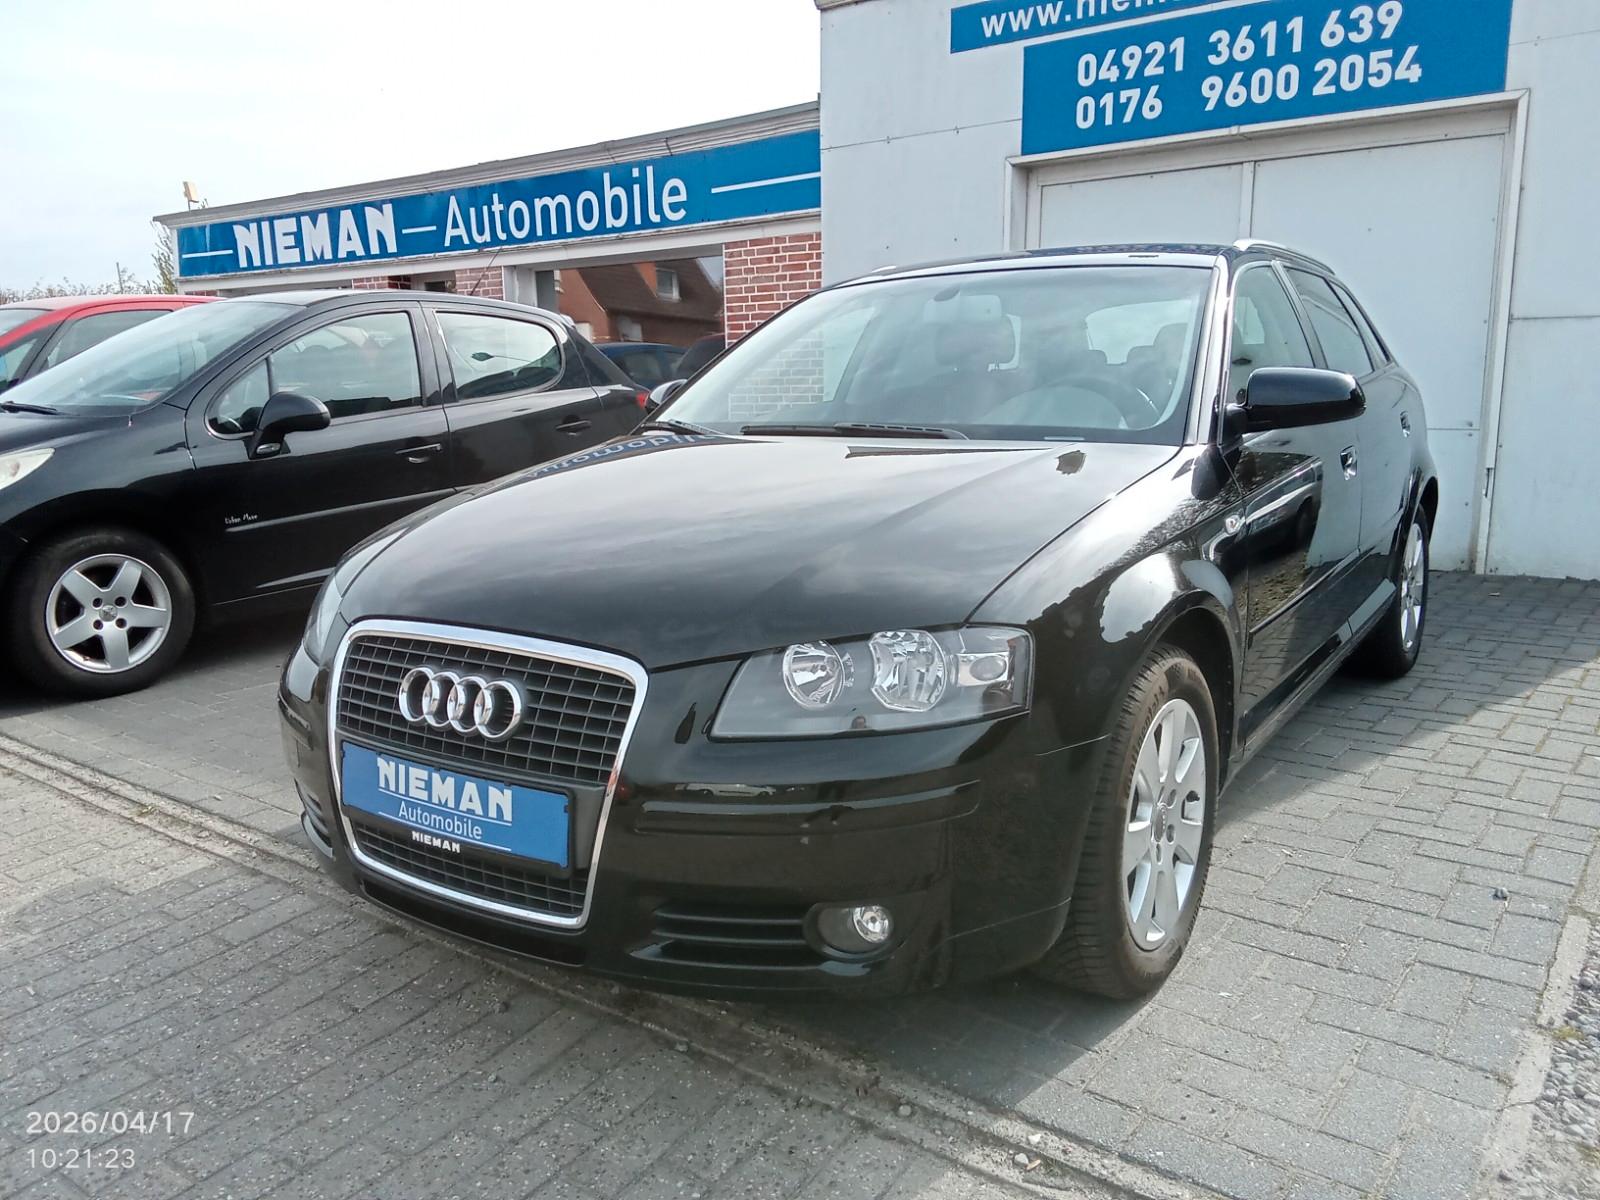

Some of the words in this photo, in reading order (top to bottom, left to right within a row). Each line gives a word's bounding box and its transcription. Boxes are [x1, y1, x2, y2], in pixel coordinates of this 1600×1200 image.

[1077, 36, 1185, 88] 04921
[1208, 16, 1303, 65] 3611
[1320, 1, 1403, 48] 639
[1075, 85, 1163, 129] 0176
[1201, 64, 1300, 111] 9600
[1312, 46, 1422, 96] 2054
[233, 203, 398, 268] NIEMAN
[444, 165, 688, 247] Automobile
[377, 757, 513, 822] NIEMAN
[399, 801, 483, 840] Automobile
[411, 830, 461, 853] NIEMAN
